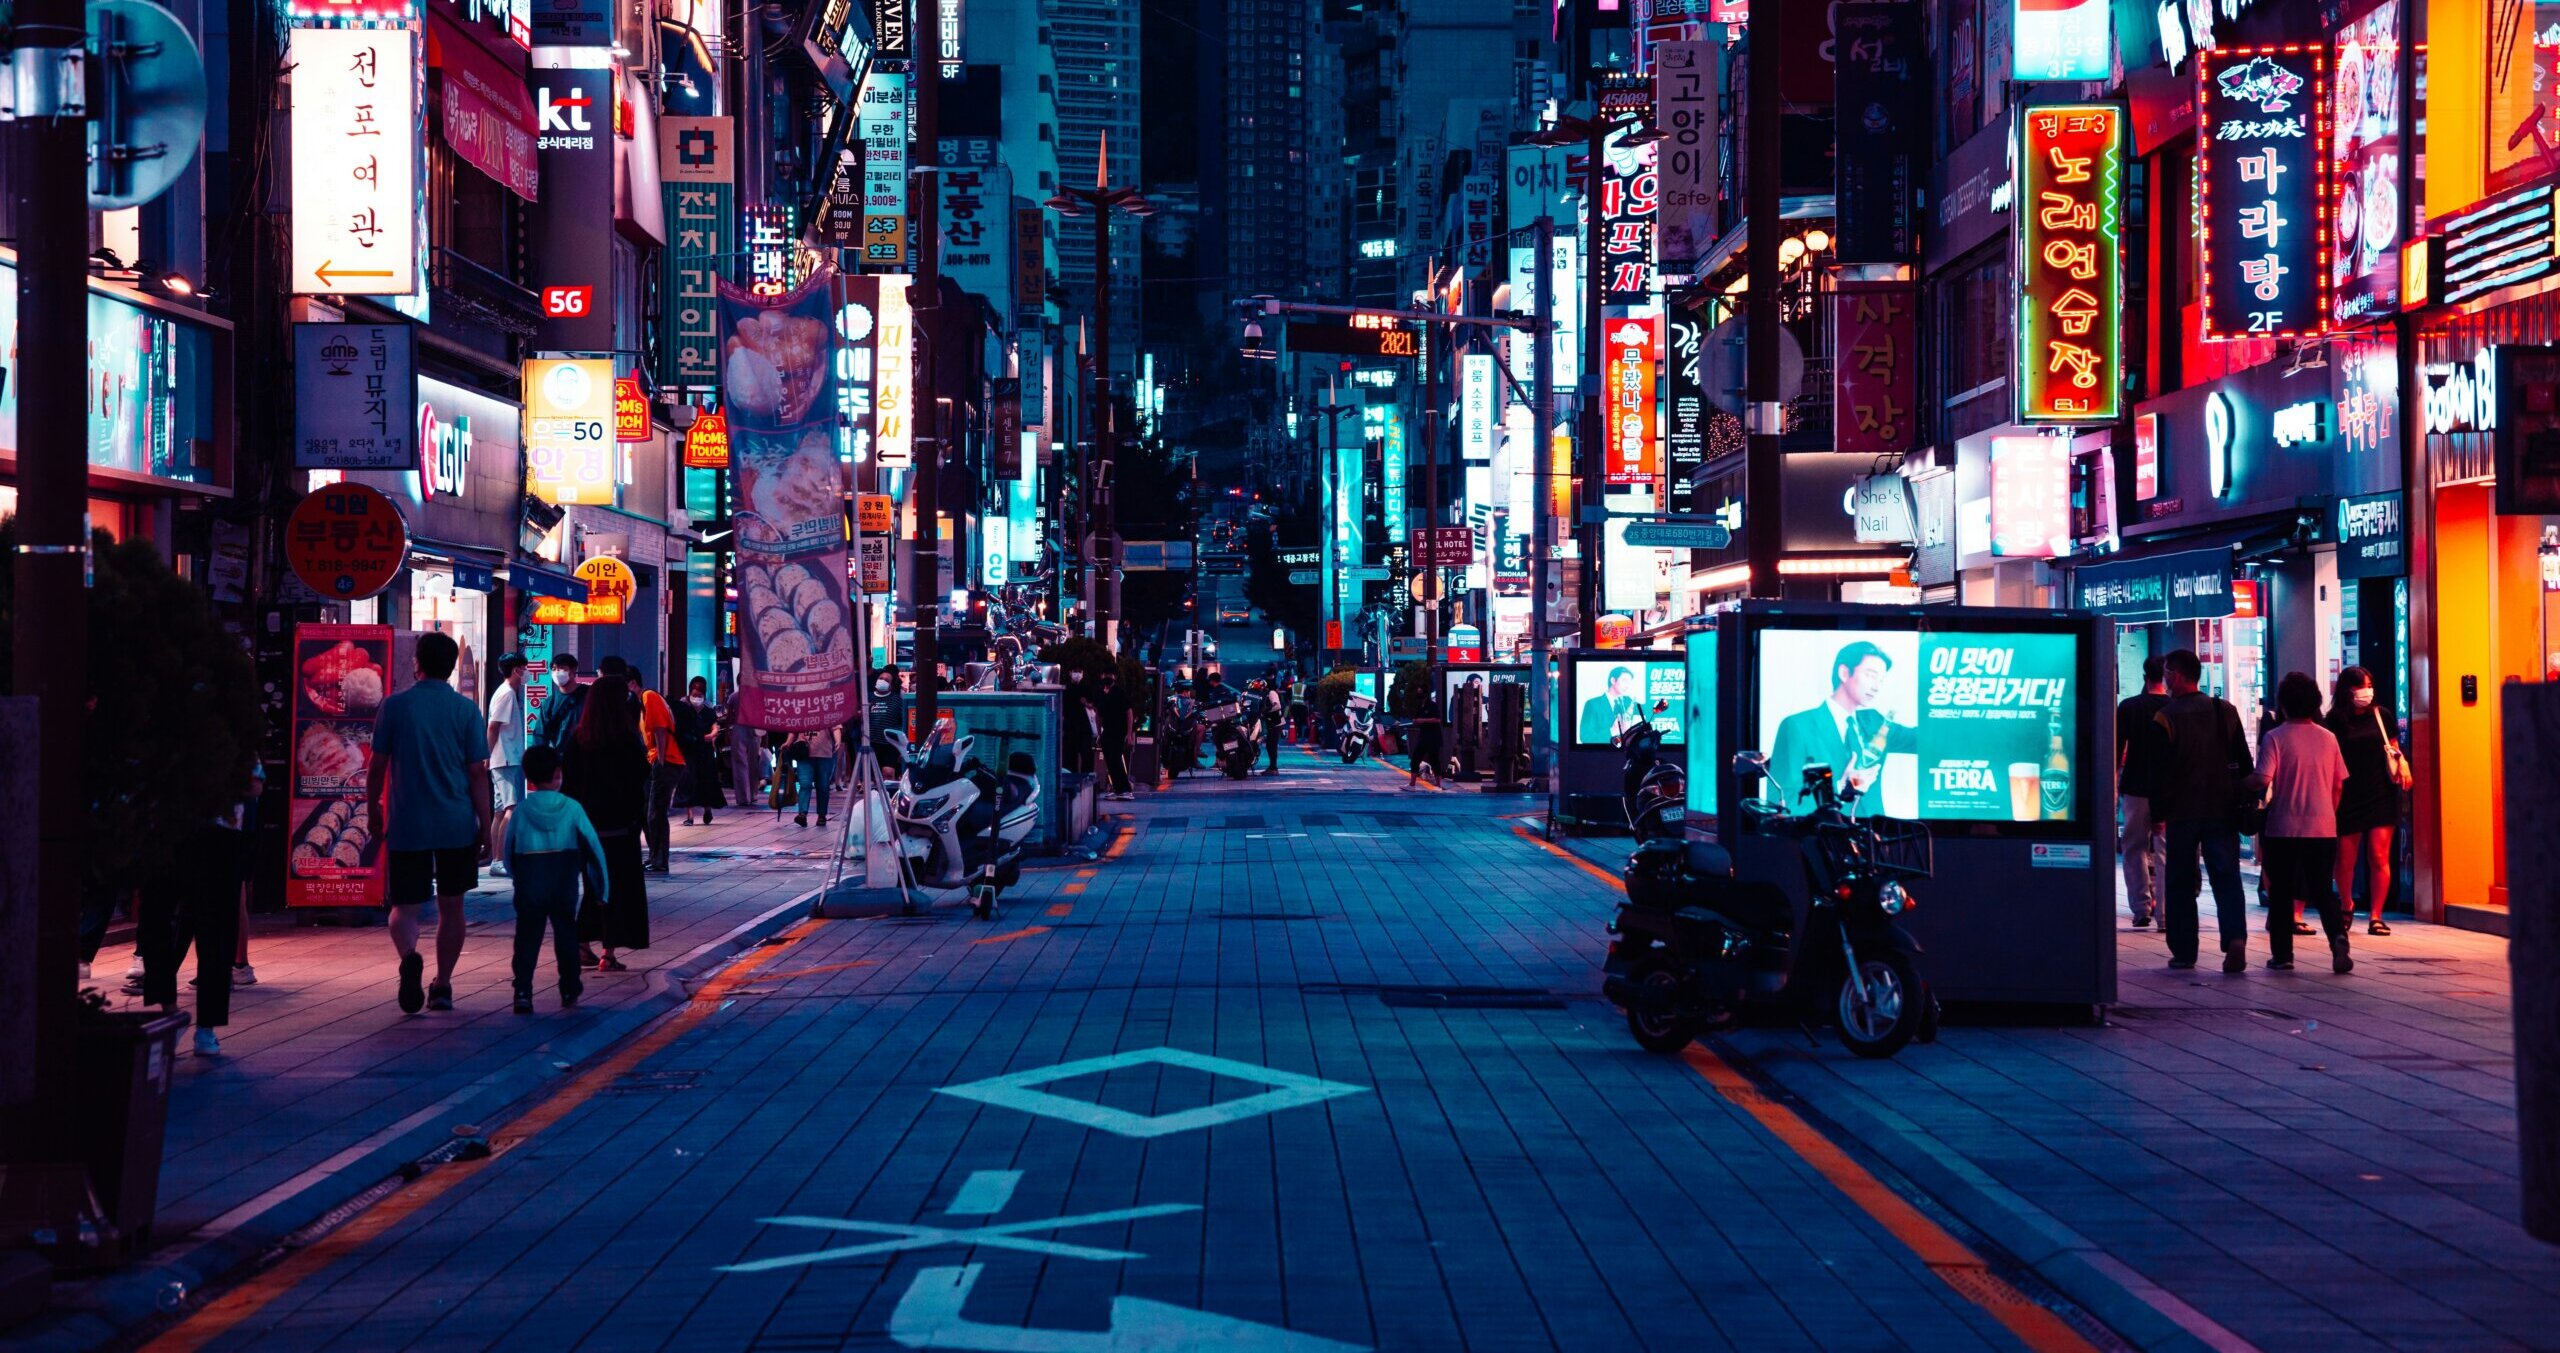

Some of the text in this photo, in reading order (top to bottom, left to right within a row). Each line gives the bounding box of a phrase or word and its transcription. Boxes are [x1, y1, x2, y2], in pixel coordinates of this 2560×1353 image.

[884, 0, 904, 51] VEN
[941, 0, 961, 58] 포비아
[943, 65, 960, 78] 5F
[2048, 60, 2076, 77] 3F
[538, 88, 592, 131] kt
[891, 113, 902, 121] 3F
[872, 125, 894, 135] 무한
[1671, 75, 1705, 184] 고양이
[345, 46, 383, 249] 전포여관
[537, 137, 594, 150] 공식대리점
[1515, 164, 1558, 196] 이지
[874, 185, 891, 197] 메뉴
[1467, 183, 1490, 196] 이지
[1666, 191, 1711, 206] Cafe
[833, 210, 853, 219] ROOM
[943, 171, 985, 246] 부동산
[834, 221, 852, 230] SOJU
[869, 219, 896, 234] 소주
[2237, 147, 2290, 302] 마라탕
[835, 231, 849, 241] HOF
[1467, 202, 1489, 266] 부동산
[868, 246, 896, 261] 호프
[1020, 224, 1041, 295] 부동산
[550, 290, 583, 314] 5G
[2247, 311, 2284, 333] 2F
[1381, 332, 1418, 356] 2021.
[1855, 293, 1906, 442] 사격장
[363, 328, 387, 436] 드림뮤직
[877, 325, 902, 438] 지구상사
[691, 446, 728, 458] TOUCH
[531, 447, 605, 484] 안경
[1861, 489, 1900, 504] She's
[863, 501, 884, 511] 장원
[1861, 516, 1888, 532] Nail
[296, 519, 398, 553] 부동산
[1444, 540, 1467, 548] HOTEL
[586, 563, 617, 577] 이안
[989, 553, 1003, 578] CU
[586, 603, 617, 618] TOUCH
[1930, 647, 2014, 676] 이 맛이
[1650, 668, 1662, 681] 이
[1928, 675, 2066, 707] 청정라거다!
[1651, 720, 1681, 732] TERRA
[301, 776, 340, 787] 비빔만두
[1929, 768, 1998, 792] TERRA
[2041, 780, 2067, 790] TERRA
